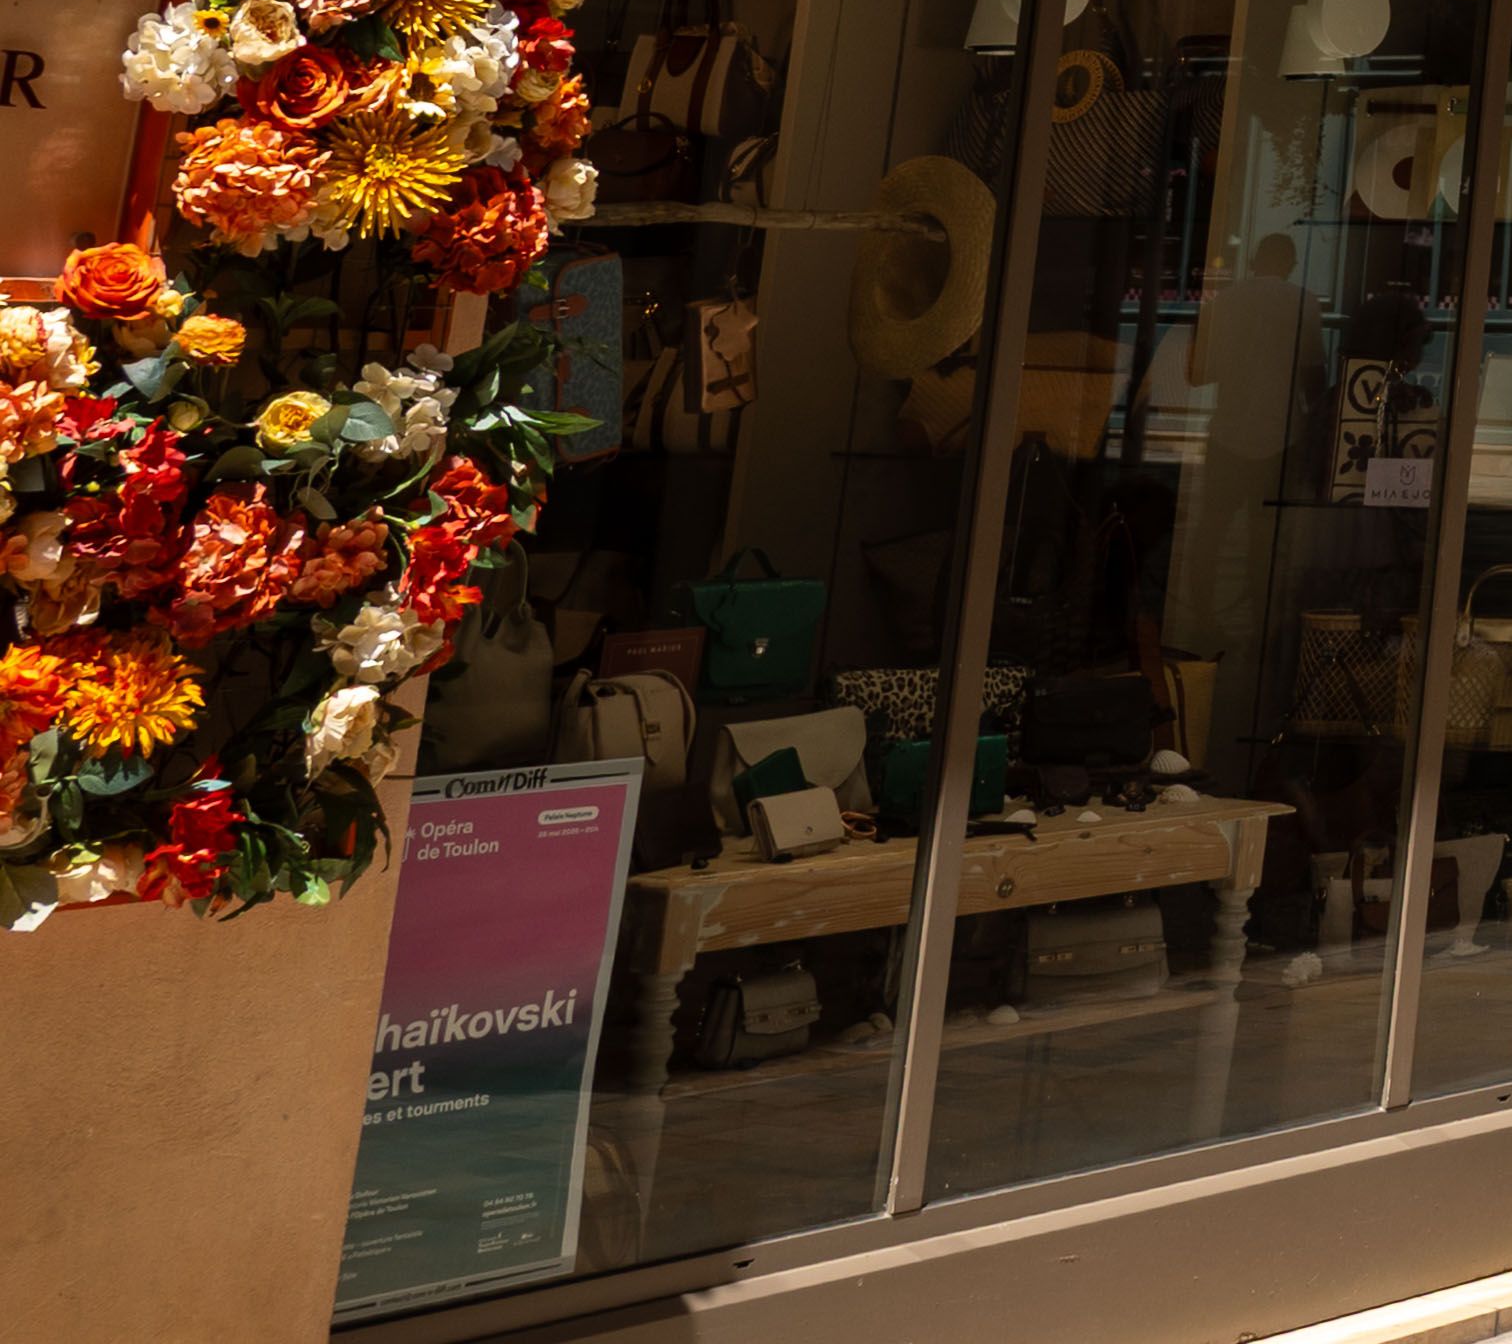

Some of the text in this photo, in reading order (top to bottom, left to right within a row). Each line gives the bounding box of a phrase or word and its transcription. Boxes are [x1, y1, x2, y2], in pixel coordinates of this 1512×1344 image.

[420, 818, 474, 842] Opéra
[417, 839, 499, 861] de Toulon
[375, 988, 578, 1054] haïkovski
[386, 1107, 403, 1122] et
[407, 1093, 491, 1119] tourments
